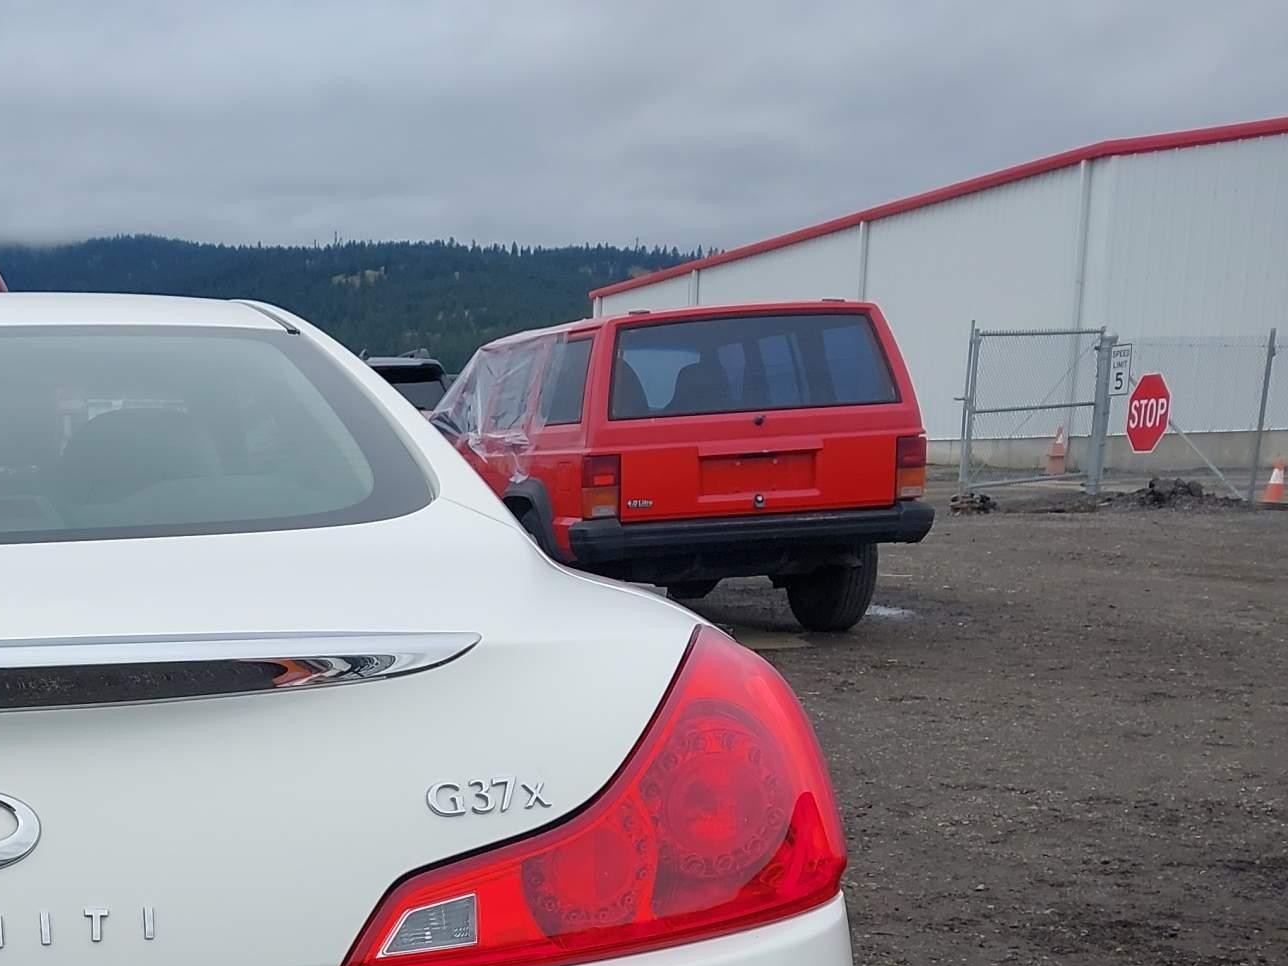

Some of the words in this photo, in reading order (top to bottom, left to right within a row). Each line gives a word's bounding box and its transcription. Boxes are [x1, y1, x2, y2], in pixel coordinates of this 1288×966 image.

[1112, 349, 1130, 359] SPEED
[1113, 360, 1128, 369] LIMIT
[1115, 372, 1123, 390] 5
[1129, 398, 1167, 428] STOP
